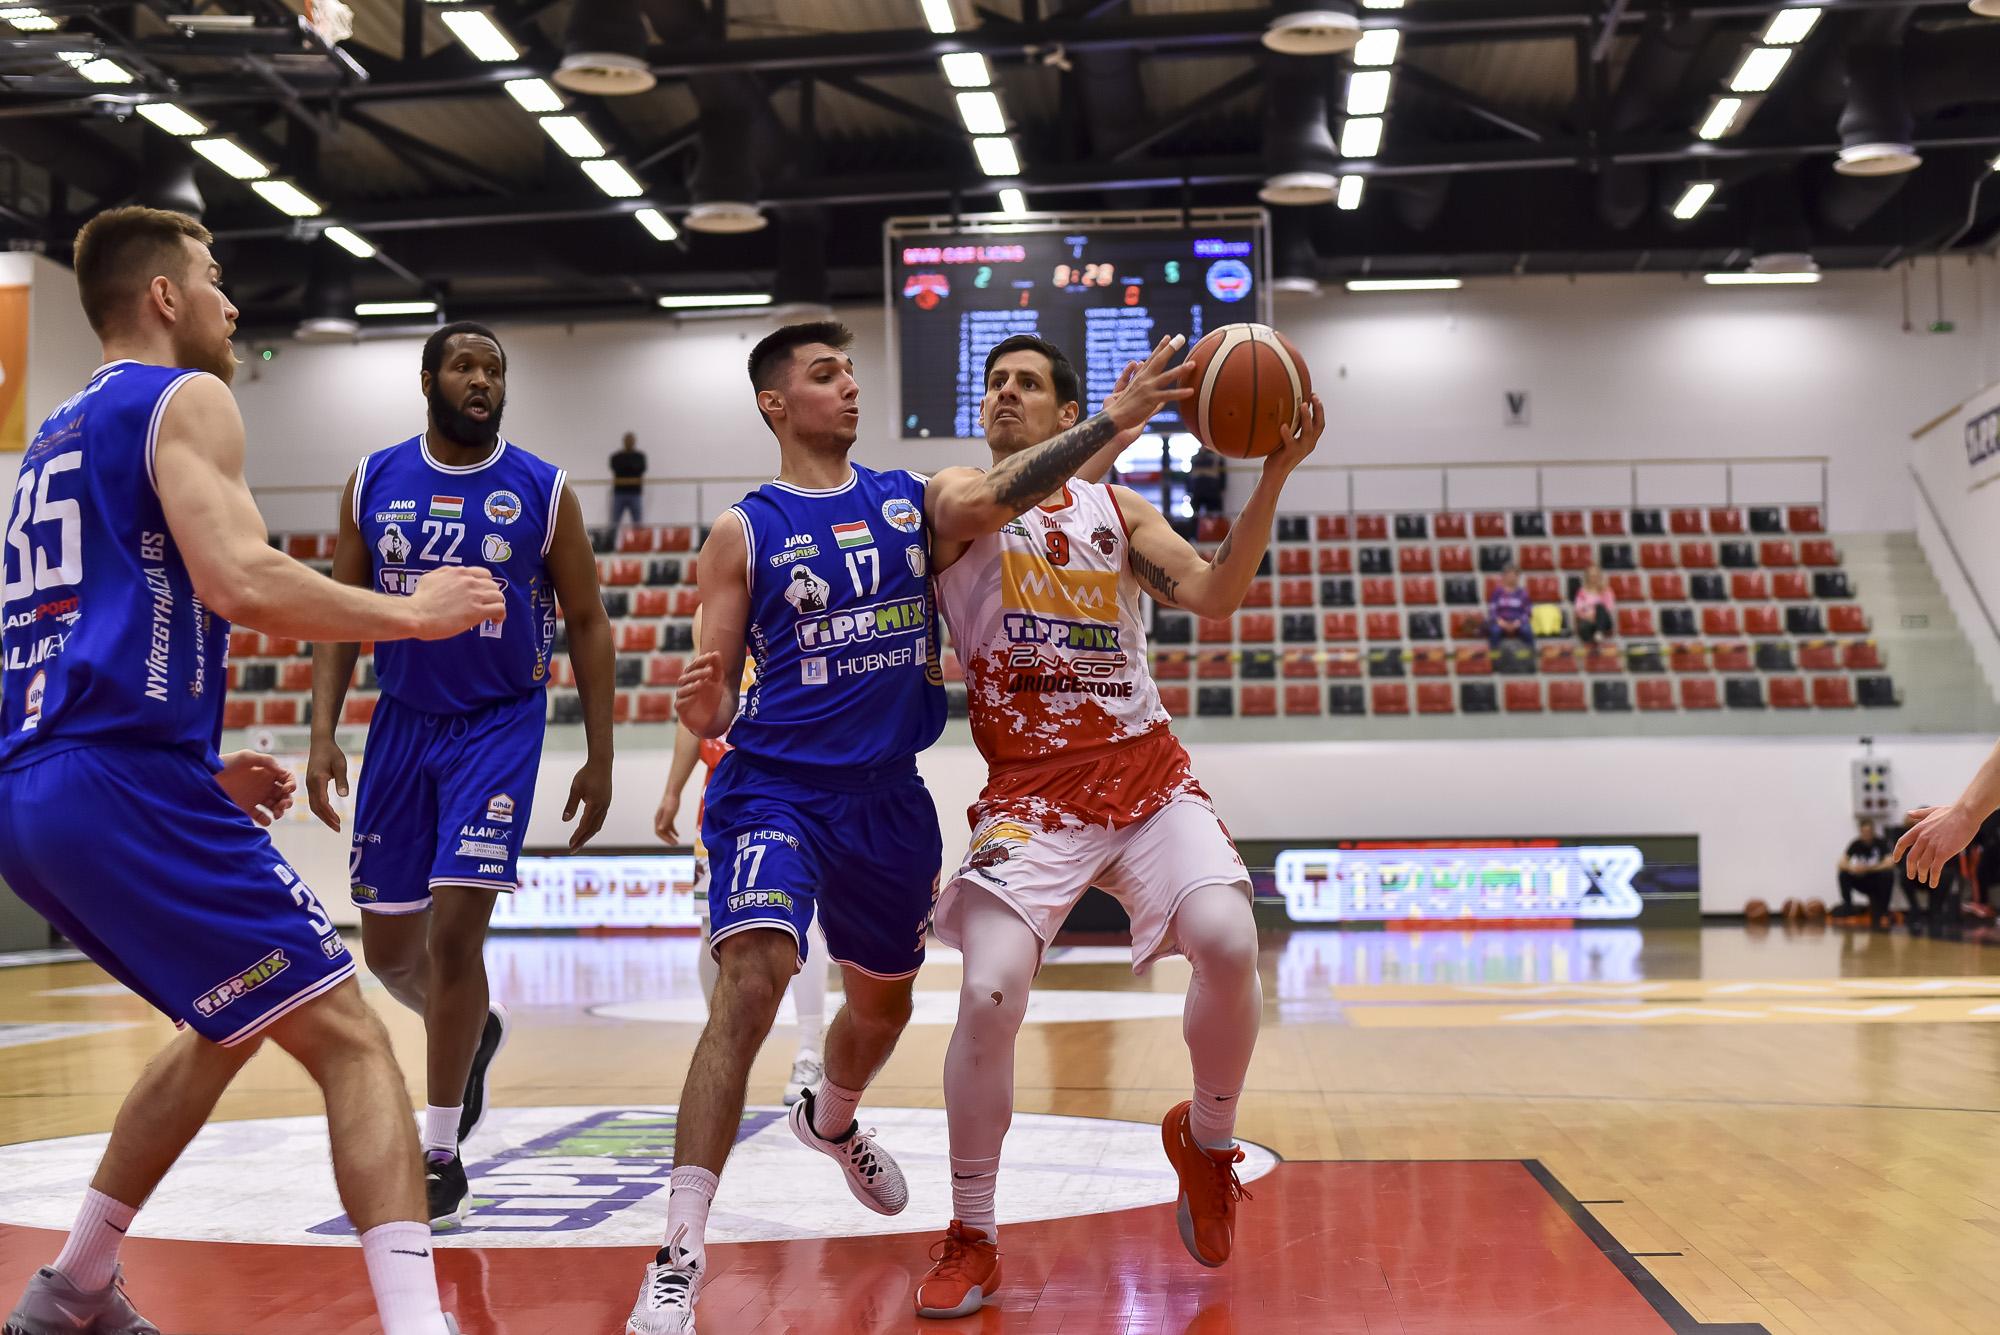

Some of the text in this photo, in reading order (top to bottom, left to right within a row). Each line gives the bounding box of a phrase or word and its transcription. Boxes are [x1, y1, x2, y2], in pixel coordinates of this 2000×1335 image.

[389, 499, 416, 510] JAKO
[141, 530, 165, 561] BS
[419, 520, 466, 564] 22
[784, 534, 813, 548] JAKO
[1044, 531, 1070, 567] 9
[845, 547, 880, 598] 17
[837, 647, 912, 677] HÜBNER
[1008, 673, 1133, 698] BRIDGESTONE
[460, 824, 513, 840] ALANEX
[754, 830, 800, 851] HÜBNER
[478, 863, 505, 875] JAKO
[731, 845, 766, 893] 17
